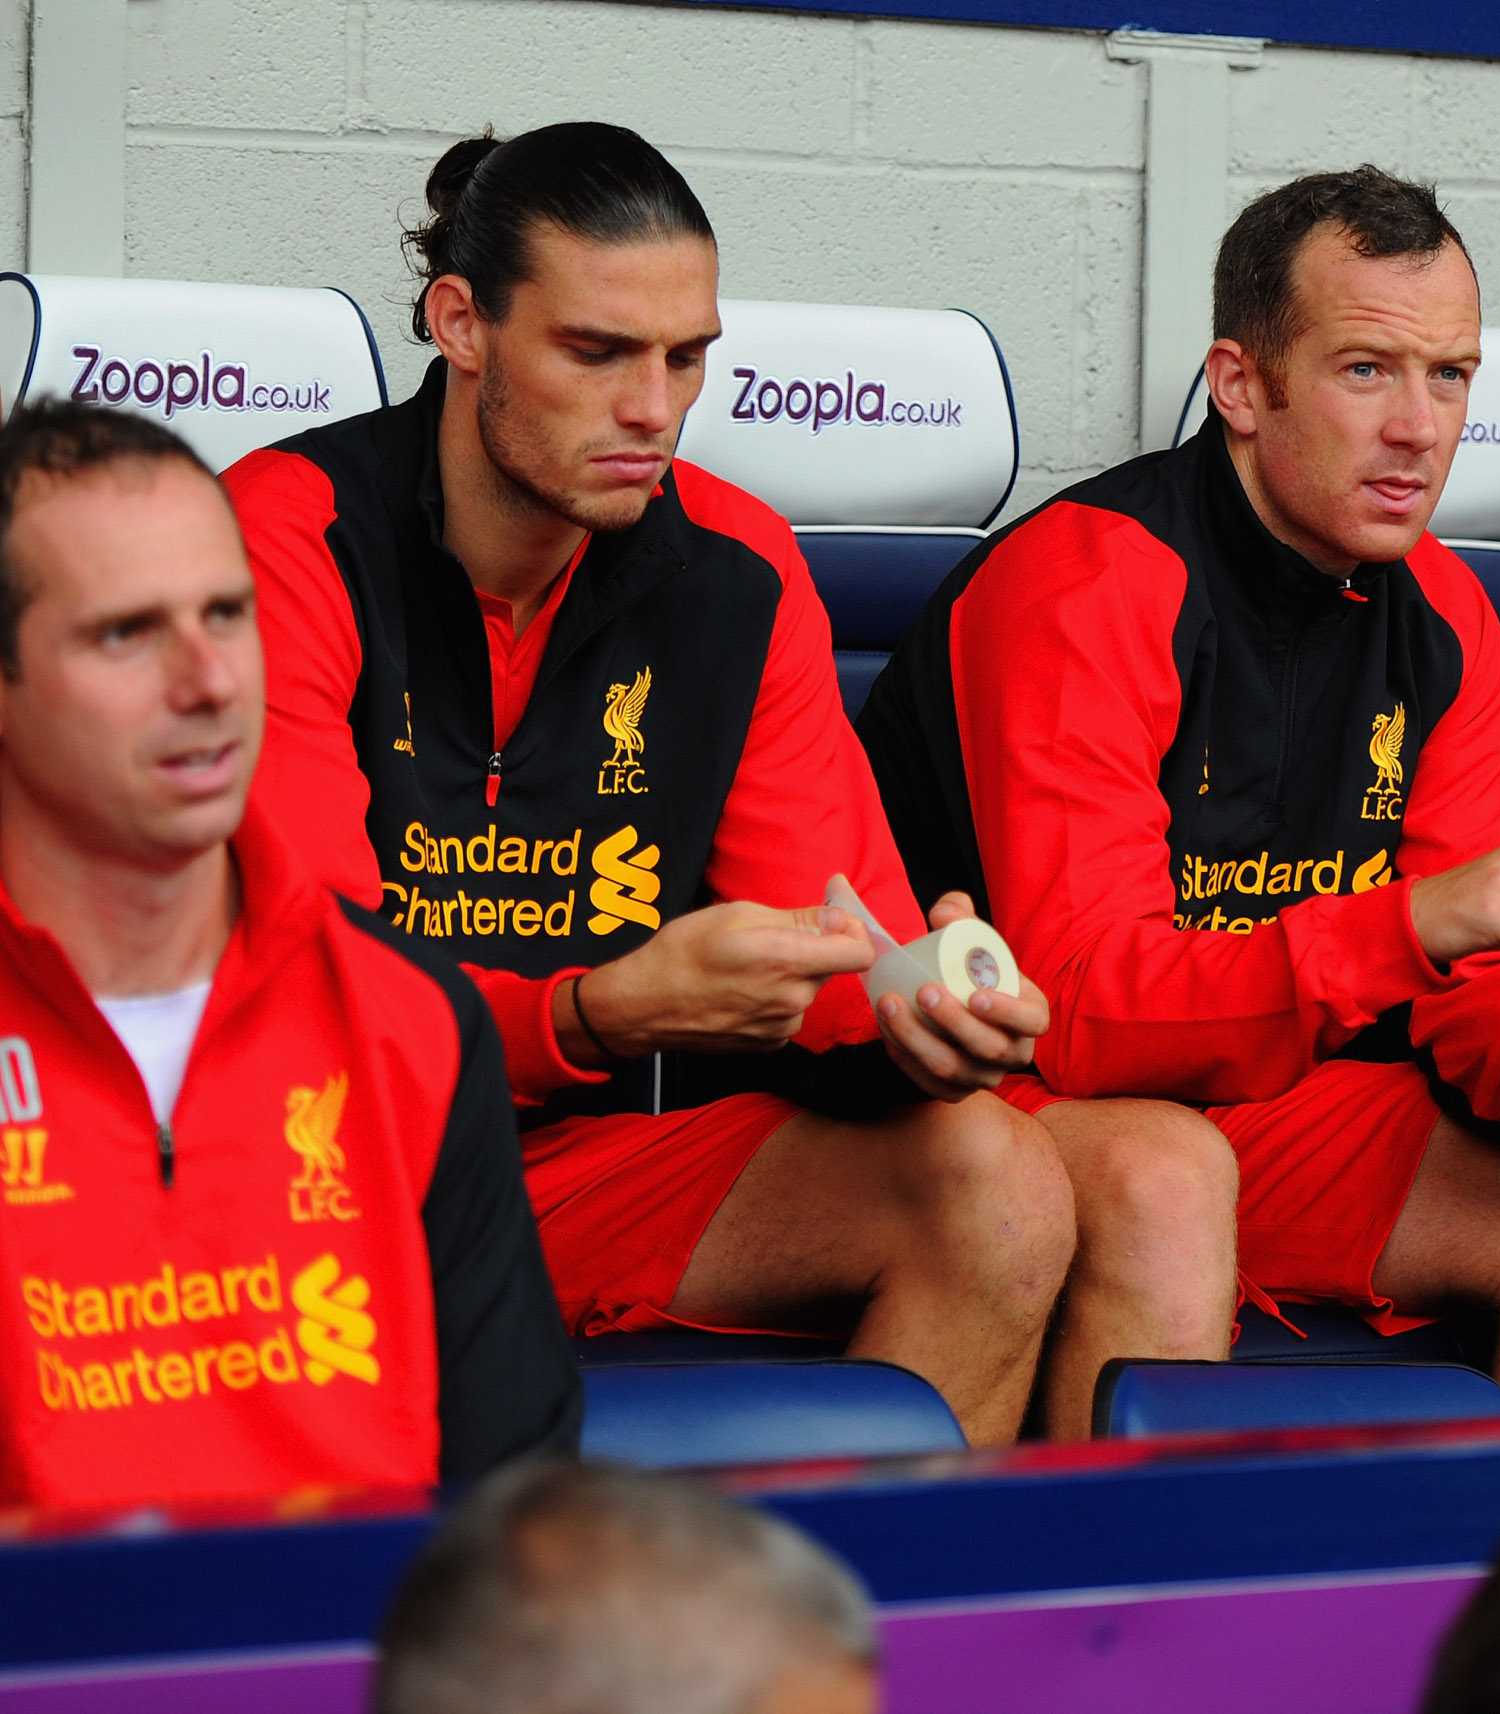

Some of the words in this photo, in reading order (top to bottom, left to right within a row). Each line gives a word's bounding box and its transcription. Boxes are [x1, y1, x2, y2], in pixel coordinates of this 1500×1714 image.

[71, 347, 331, 417] Zoopla.co.uk
[731, 366, 963, 432] Zoopla.co.uk
[597, 768, 649, 795] L.F.C.
[1181, 850, 1346, 901] Standard
[22, 1252, 283, 1338] Standard
[36, 1327, 301, 1411] Chartered
